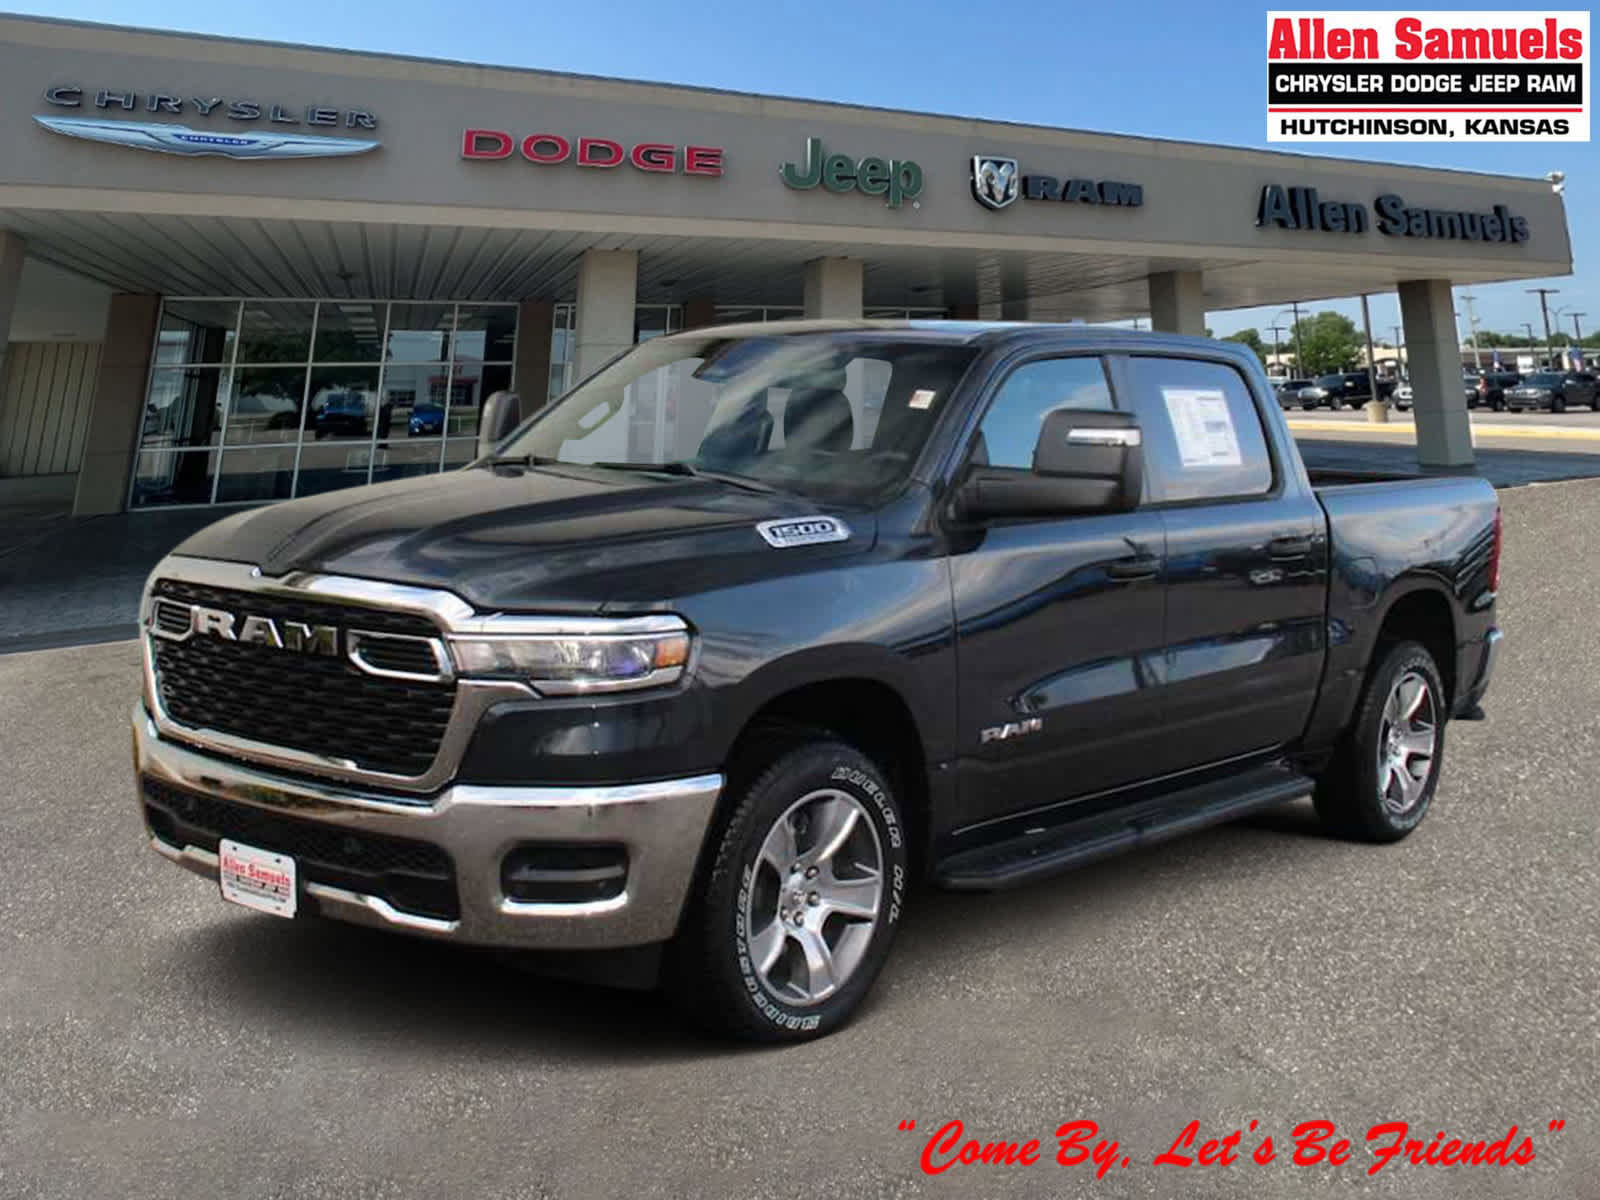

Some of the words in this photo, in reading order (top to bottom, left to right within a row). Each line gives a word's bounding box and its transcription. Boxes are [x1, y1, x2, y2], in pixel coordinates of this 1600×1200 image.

[44, 86, 378, 129] CHRYSLER
[461, 128, 725, 177] DODGE
[779, 136, 923, 209] Jeep
[1022, 176, 1143, 206] RAM
[1256, 184, 1369, 233] Allen
[1374, 194, 1530, 243] Samuels
[768, 521, 835, 537] 1500
[191, 604, 338, 656] RAM
[981, 717, 1042, 744] RAM
